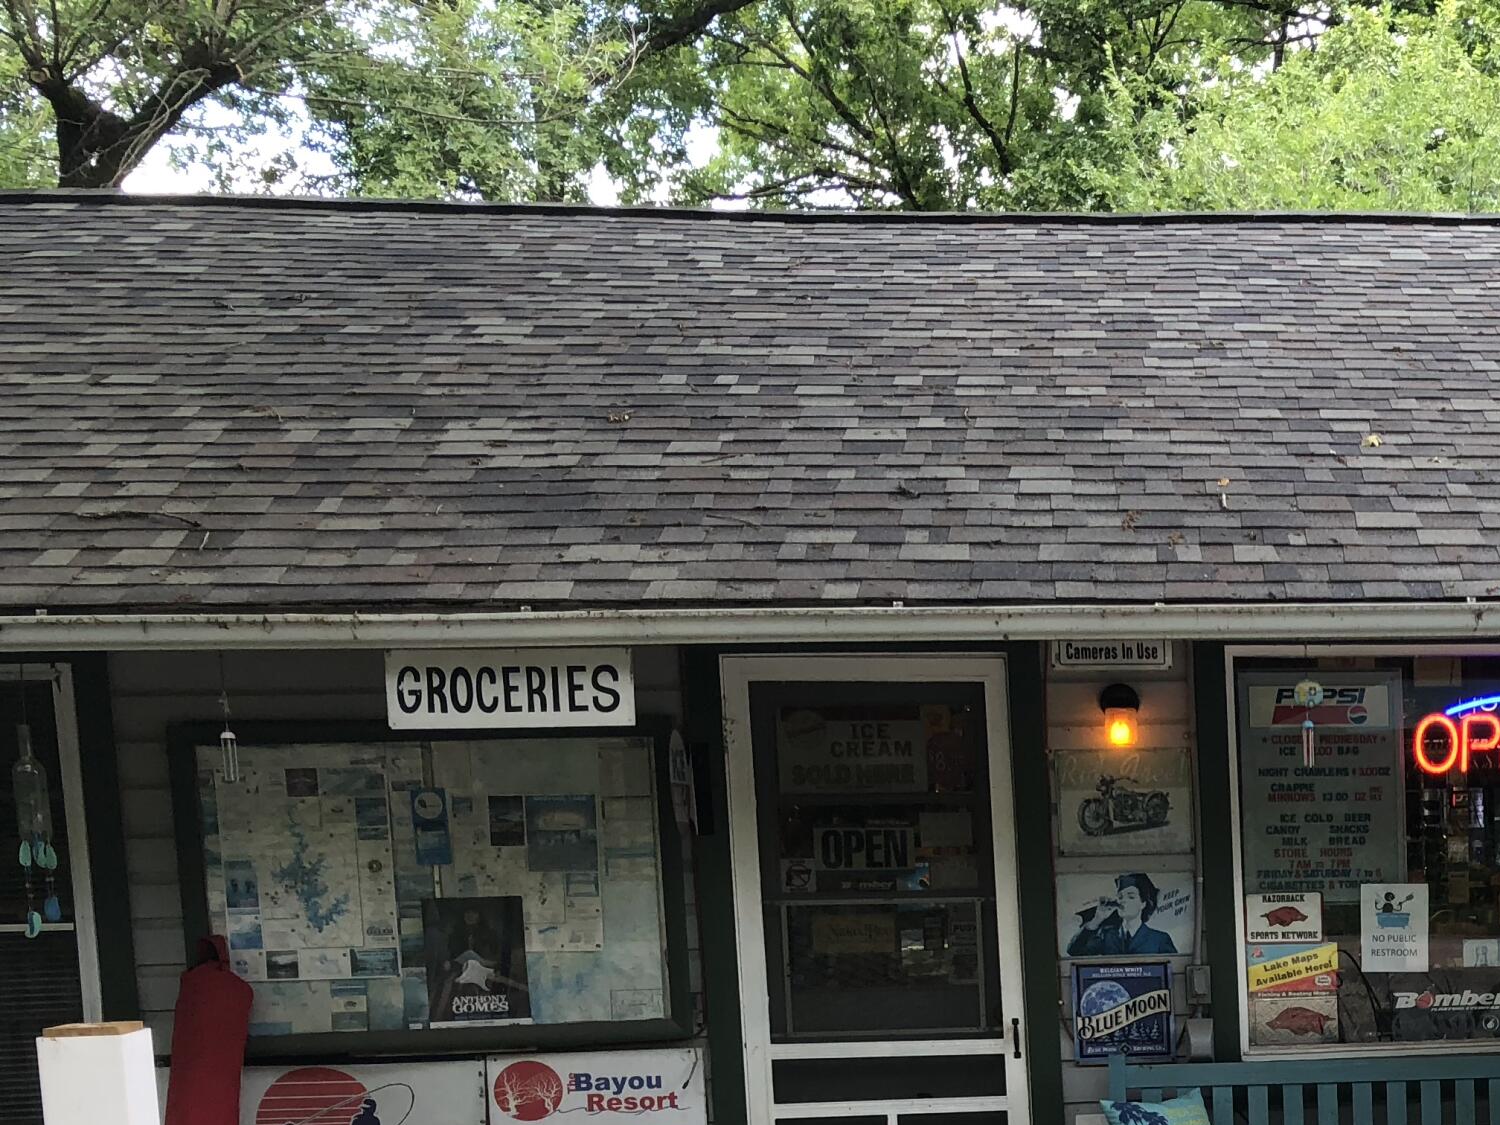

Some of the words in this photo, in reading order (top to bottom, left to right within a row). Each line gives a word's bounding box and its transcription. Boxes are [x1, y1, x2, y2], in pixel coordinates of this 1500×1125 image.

[1065, 642, 1118, 660] Cameras
[1121, 642, 1133, 659] In
[1136, 642, 1158, 659] Use
[396, 664, 621, 714] GROCERIES
[1275, 687, 1366, 704] PPSI
[850, 723, 891, 739] ICE
[1271, 735, 1309, 744] CLOSE
[830, 741, 913, 757] CREAM
[1279, 746, 1296, 756] ICE
[1294, 767, 1349, 777] CRAWLERS
[1270, 783, 1315, 792] CRAPPIE
[1280, 813, 1297, 823] ICE
[1304, 813, 1334, 823] COLD
[1344, 813, 1371, 822] BEER
[1265, 825, 1301, 835] CANDY
[1329, 824, 1369, 834] SNACKS
[1282, 837, 1308, 846] MILK
[1328, 836, 1366, 846] BREAD
[822, 829, 908, 869] OPEN
[1274, 848, 1309, 858] STORE
[1319, 847, 1353, 857] HOURS
[1259, 880, 1325, 890] CIGARETTES
[1262, 894, 1305, 903] RAZORBACK
[1250, 932, 1279, 940] SPORTS
[1281, 931, 1319, 940] NETWORK
[1371, 935, 1386, 943] NO
[1387, 934, 1417, 943] PUBLIC
[1371, 948, 1418, 957] RESTROOM
[1263, 960, 1289, 972] Lake
[1291, 953, 1319, 965] Maps
[1255, 969, 1302, 987] Available
[1305, 960, 1333, 974] Here!
[452, 995, 507, 1005] ANTHONY
[452, 1001, 509, 1014] GOMES
[1078, 1010, 1123, 1041] BLUE
[1125, 992, 1168, 1021] MOON
[567, 1072, 577, 1094] The
[574, 1073, 662, 1095] Bayou
[586, 1091, 679, 1112] Resort
